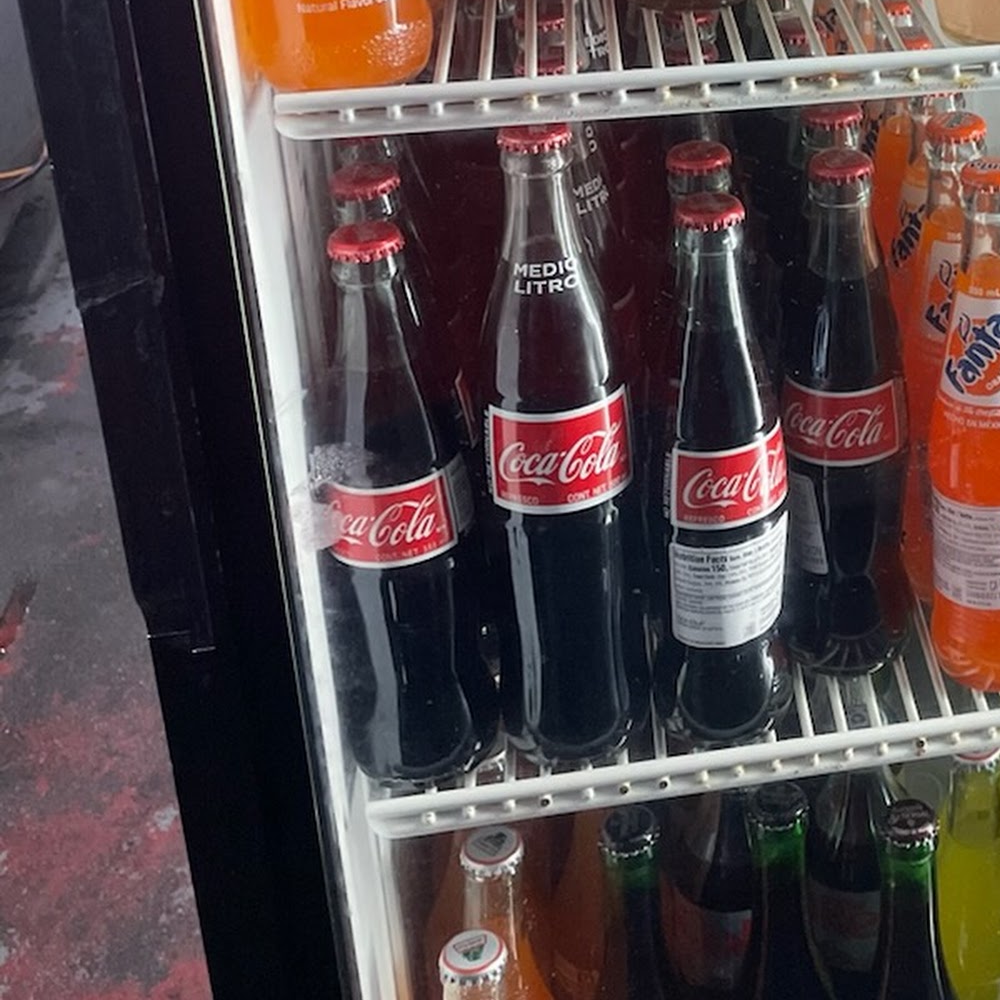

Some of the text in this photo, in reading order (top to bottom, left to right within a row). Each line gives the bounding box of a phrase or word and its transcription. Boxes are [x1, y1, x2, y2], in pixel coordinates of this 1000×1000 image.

[513, 256, 578, 279] MEDIO
[514, 271, 580, 296] LITRO
[785, 402, 888, 450] Coca-Cola
[498, 419, 624, 486] Coca-Cola
